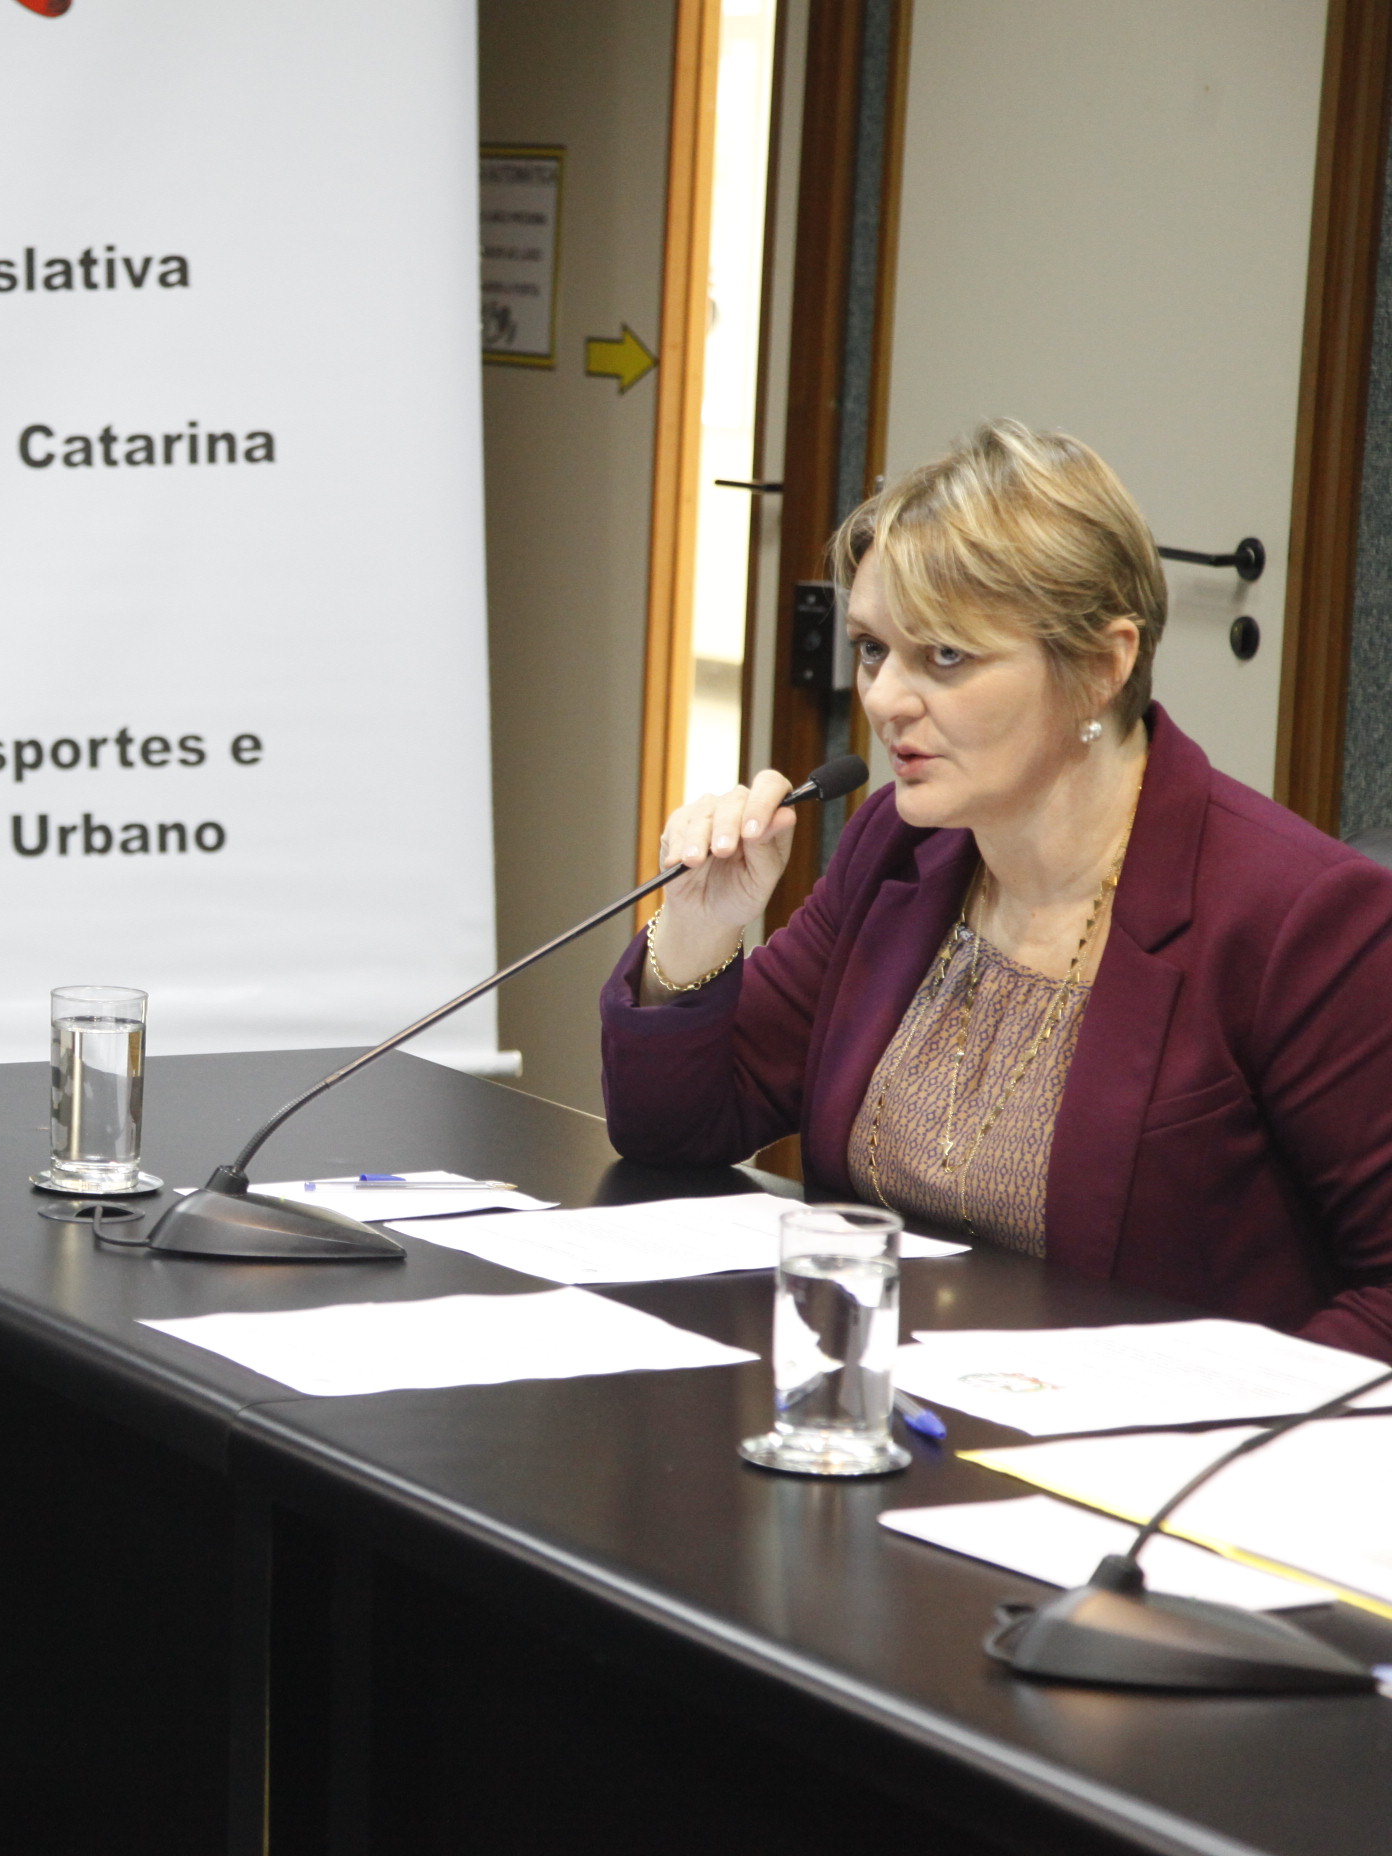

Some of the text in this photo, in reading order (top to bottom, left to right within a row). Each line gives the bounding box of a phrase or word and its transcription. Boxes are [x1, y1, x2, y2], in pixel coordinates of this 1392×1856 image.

[19, 421, 276, 470] Catarina
[231, 733, 263, 767] e
[12, 813, 227, 858] Urbano
